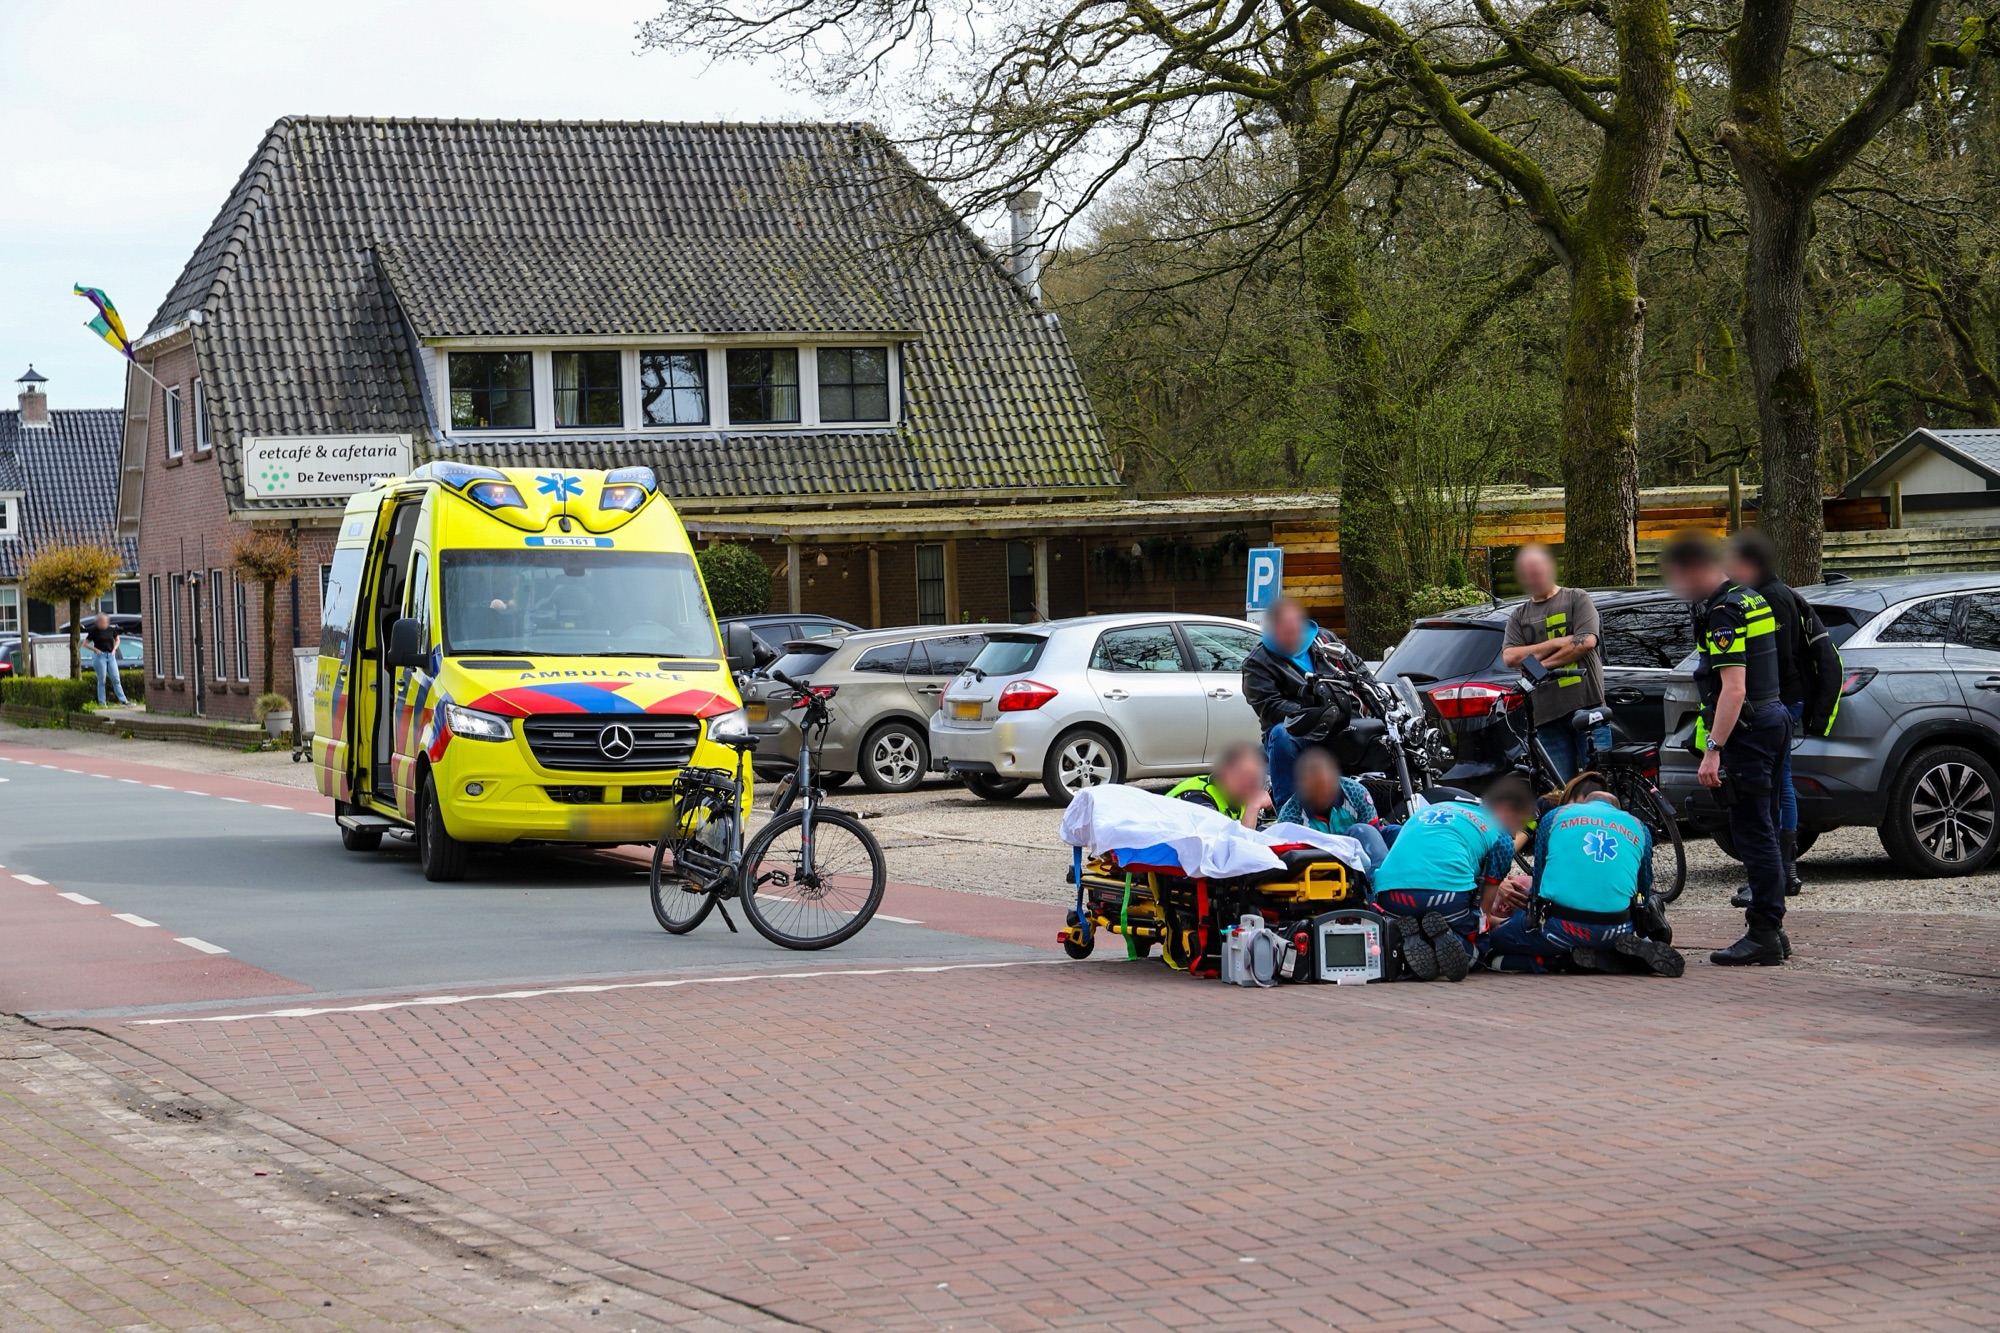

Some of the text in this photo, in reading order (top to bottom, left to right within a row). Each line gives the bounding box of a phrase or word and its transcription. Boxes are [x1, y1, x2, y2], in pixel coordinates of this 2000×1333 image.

[259, 444, 397, 462] eetcafé & cafetaria
[298, 472, 314, 483] De
[1252, 556, 1275, 603] P
[519, 670, 686, 682] AMBULANCE
[1559, 816, 1640, 847] AMBULANCE
